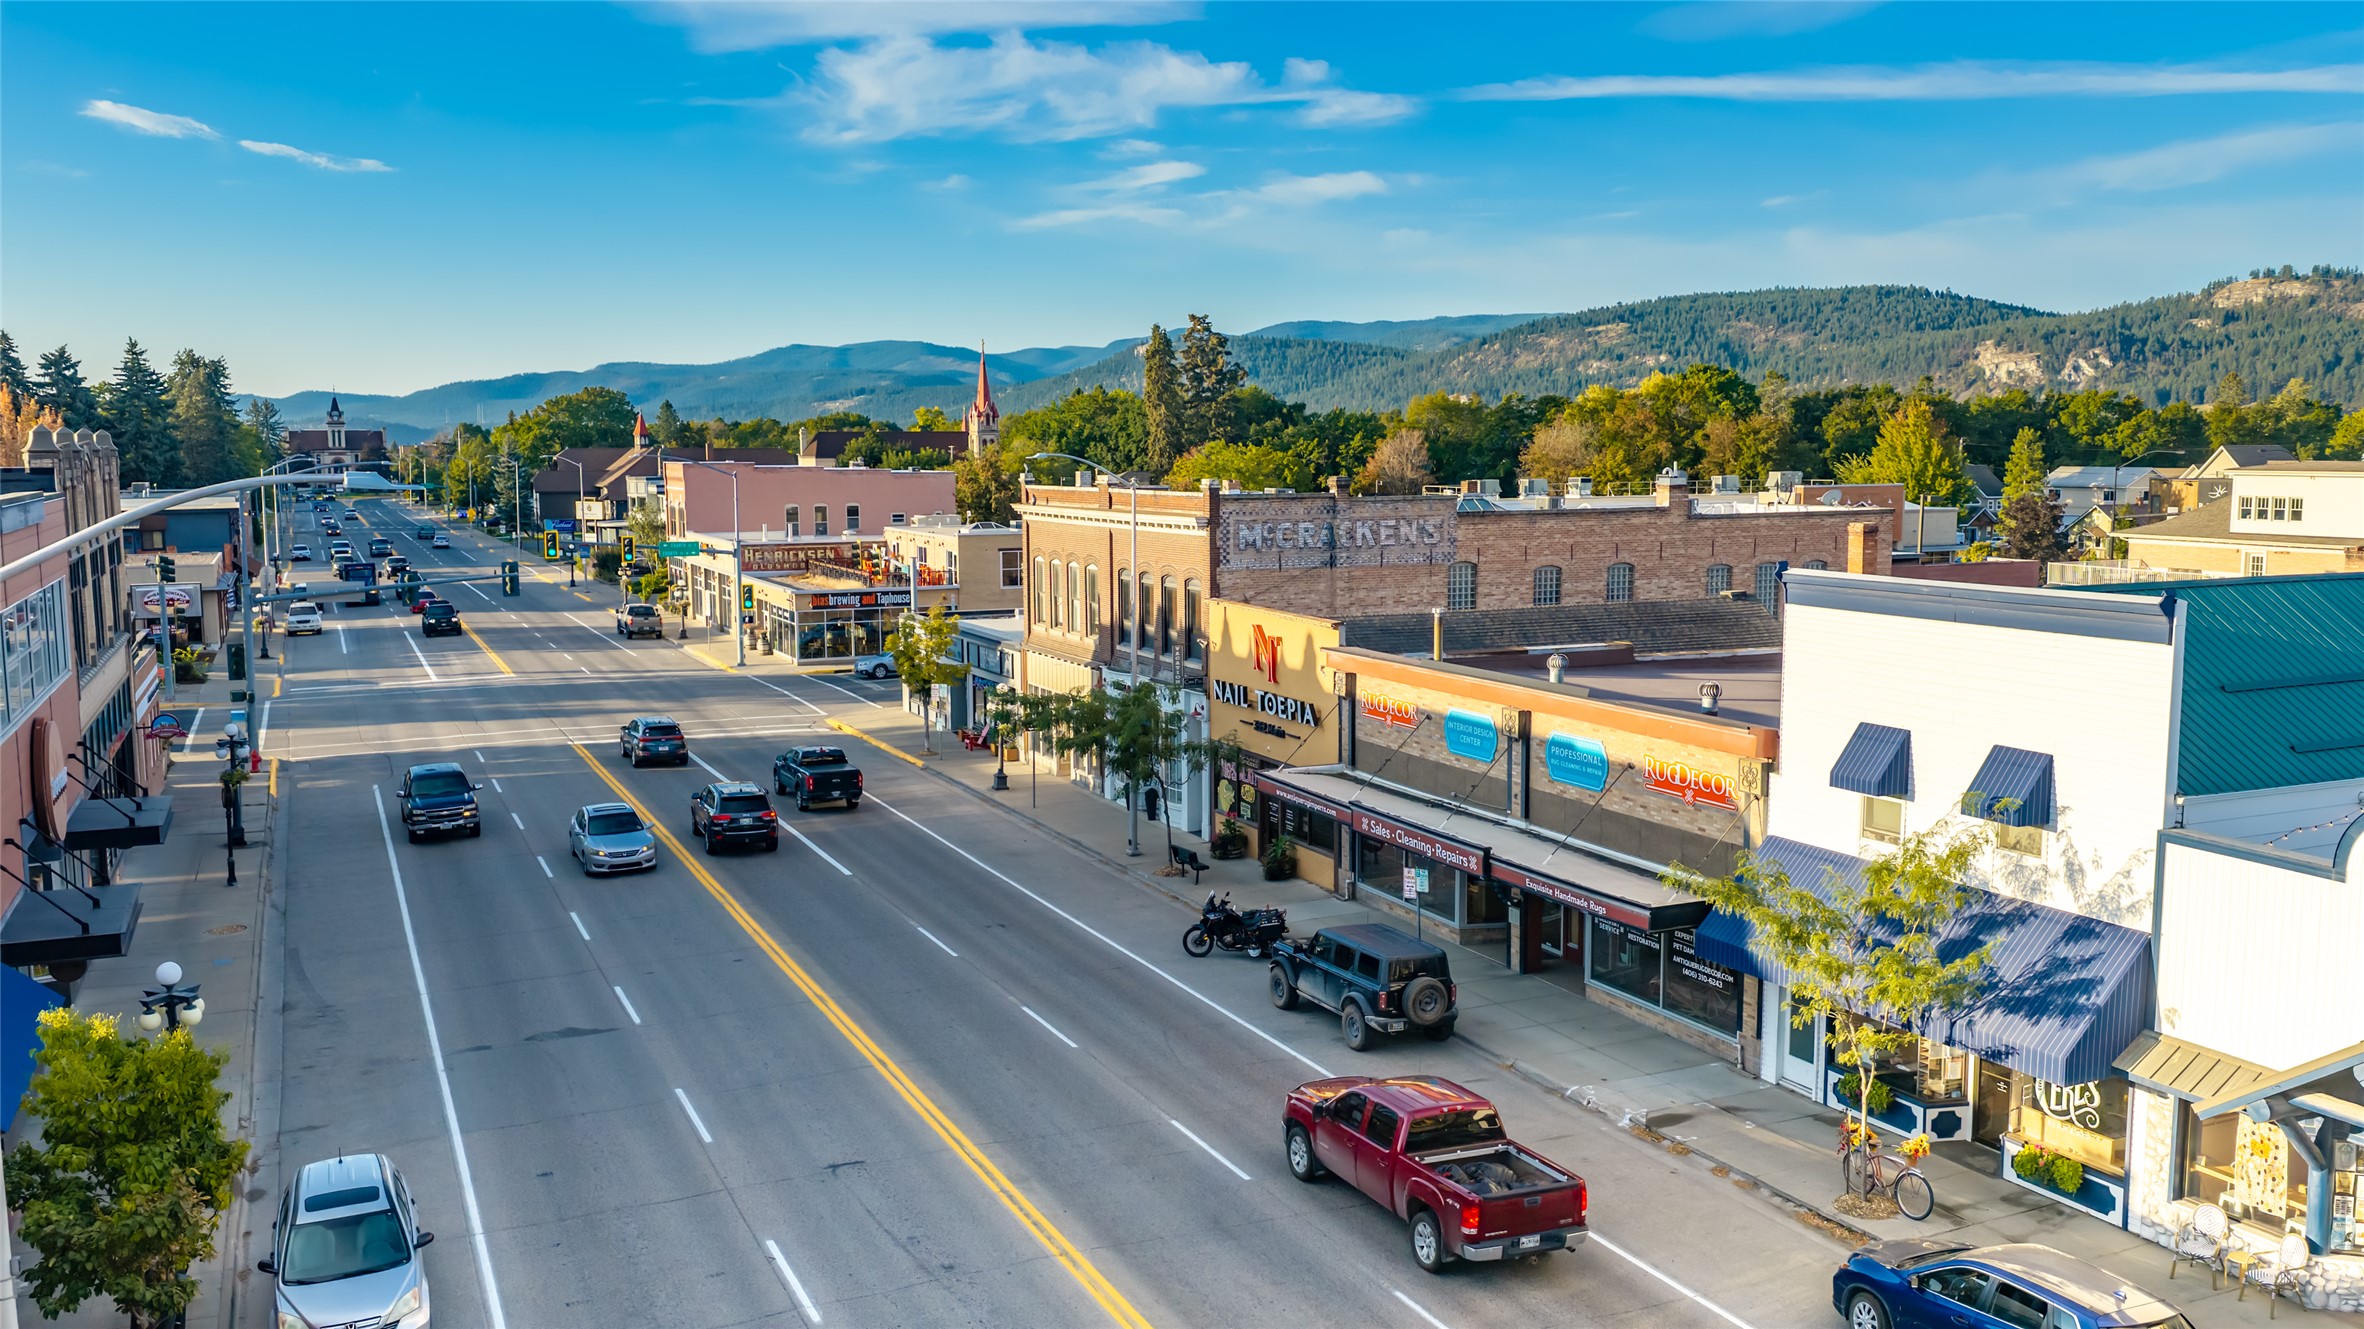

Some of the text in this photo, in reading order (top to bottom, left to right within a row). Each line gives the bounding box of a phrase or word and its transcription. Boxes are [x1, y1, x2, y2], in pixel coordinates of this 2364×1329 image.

[744, 549, 835, 563] HENRICKSEN
[862, 593, 876, 605] and
[876, 592, 911, 606] Taphouse
[1174, 646, 1182, 684] VACATION
[1213, 680, 1318, 727] NAIL TOEPIA
[1447, 721, 1494, 738] INTERIOR DESIGN
[1459, 735, 1481, 747] CENTER
[1550, 745, 1603, 767] PROFESSIONAL
[1550, 758, 1560, 766] RUG
[1560, 761, 1582, 771] CLEANING
[1586, 767, 1603, 776] REPAIR
[1370, 820, 1469, 868] Sales Cleaning Repairs
[1525, 878, 1607, 915] Exquisite Handmade Rugs
[1599, 922, 1620, 936] SERVICE
[1674, 930, 1694, 942] EXPERT
[1627, 933, 1660, 950] RESTORATION
[1672, 942, 1683, 951] PET
[1672, 955, 1734, 984] ANTIQUERUGDECOR.COM
[1682, 967, 1723, 989] (406) 310-6243
